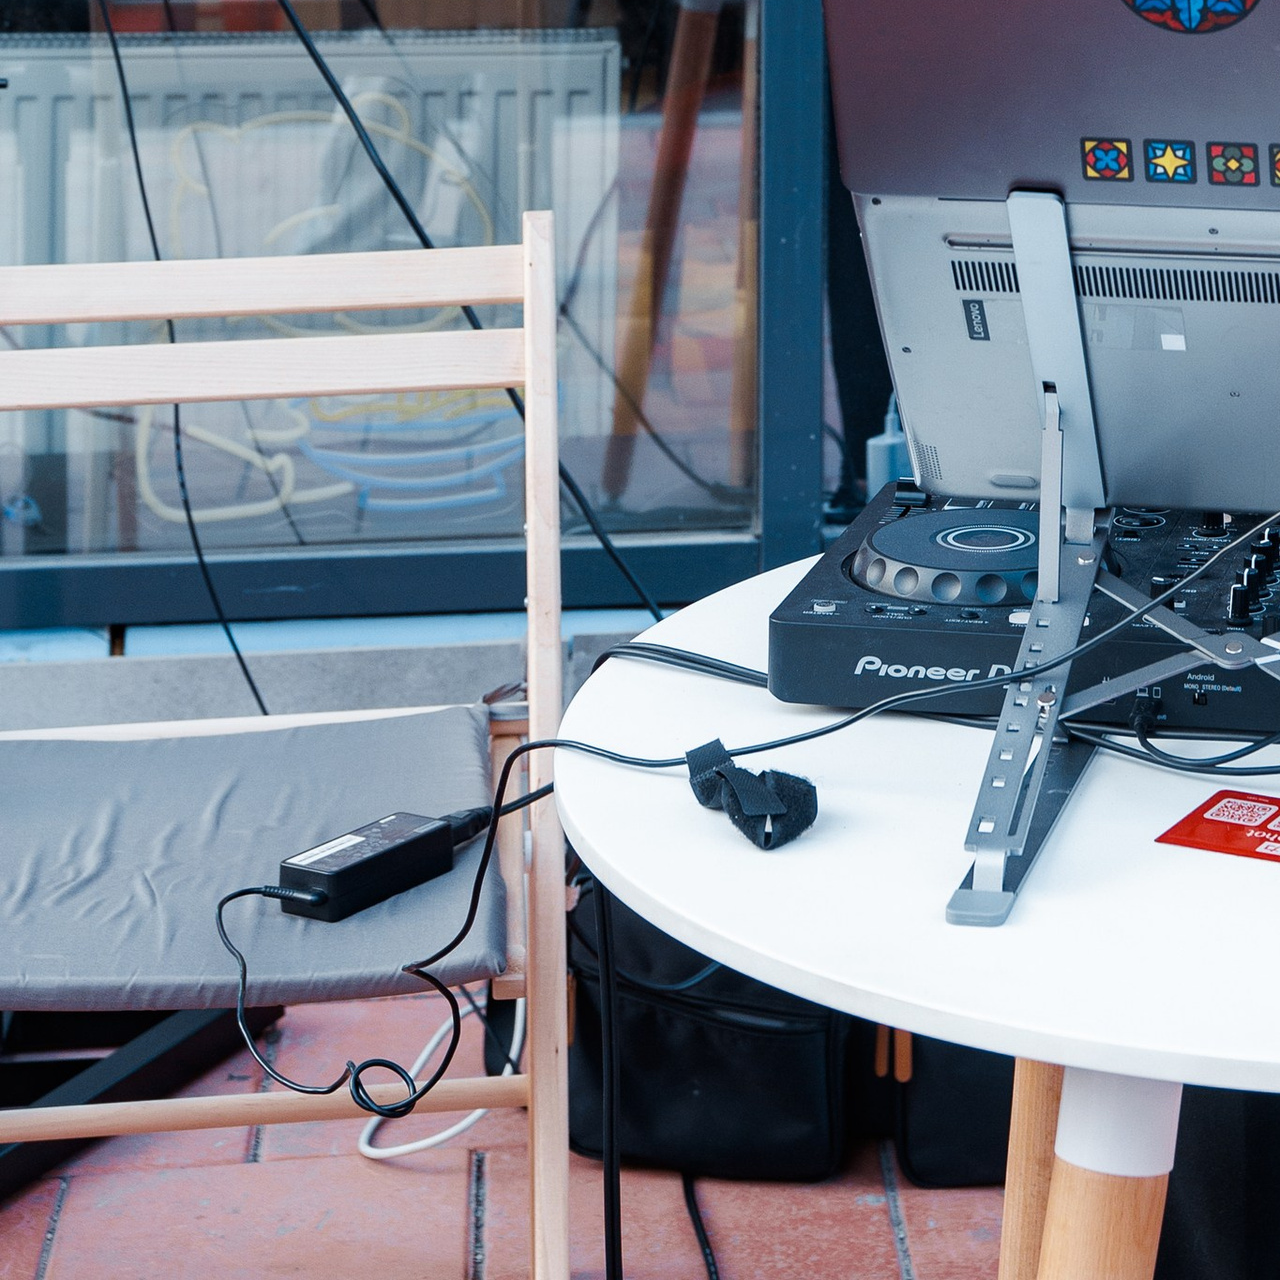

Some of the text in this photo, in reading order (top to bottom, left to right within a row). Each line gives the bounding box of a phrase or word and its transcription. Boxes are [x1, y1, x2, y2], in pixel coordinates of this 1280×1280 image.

[969, 302, 986, 339] Lenovo
[853, 655, 981, 682] Pioneer
[1187, 672, 1215, 681] Android
